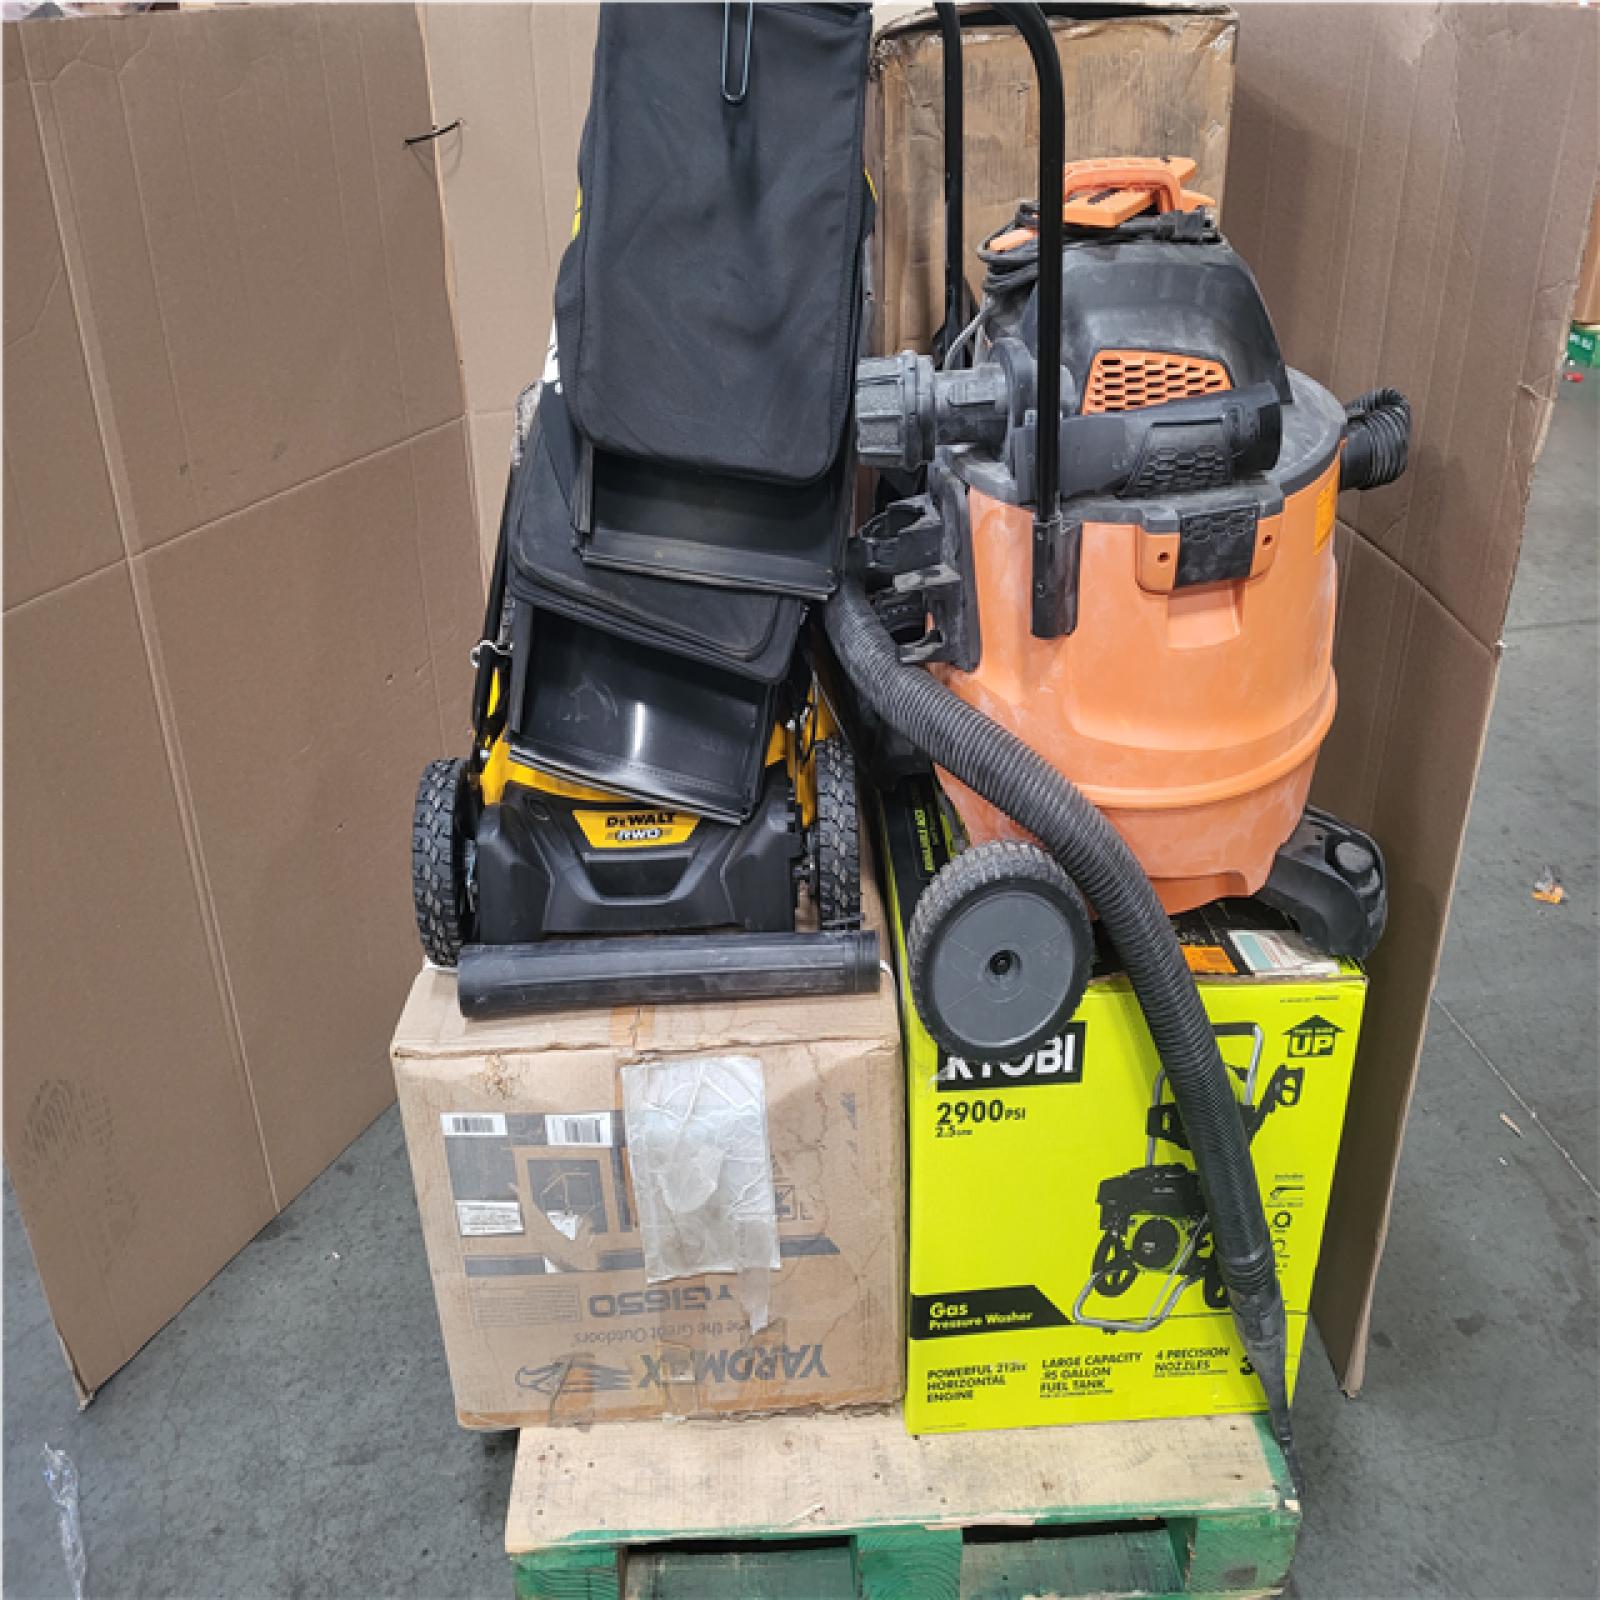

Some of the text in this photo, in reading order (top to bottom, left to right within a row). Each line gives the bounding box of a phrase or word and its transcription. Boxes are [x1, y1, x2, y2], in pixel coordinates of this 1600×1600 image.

[1290, 1029, 1333, 1055] UP
[936, 1099, 1026, 1125] 2900 PSI
[929, 1301, 969, 1319] Gas
[697, 1319, 724, 1337] the
[928, 1311, 1033, 1331] Pressure Washer
[573, 1325, 646, 1346] Outdoors
[1041, 1351, 1143, 1369] LARGE CAPACITY
[1155, 1346, 1231, 1361] 4 PRECISION
[639, 1343, 829, 1389] YARDMX
[927, 1363, 993, 1381] POWERFUL
[1060, 1366, 1111, 1379] GALLON
[1154, 1359, 1211, 1371] NOZZLES
[926, 1374, 1007, 1391] HORIZONTAL
[1039, 1378, 1107, 1392] FUEL TANK
[926, 1389, 975, 1404] ENGINE
